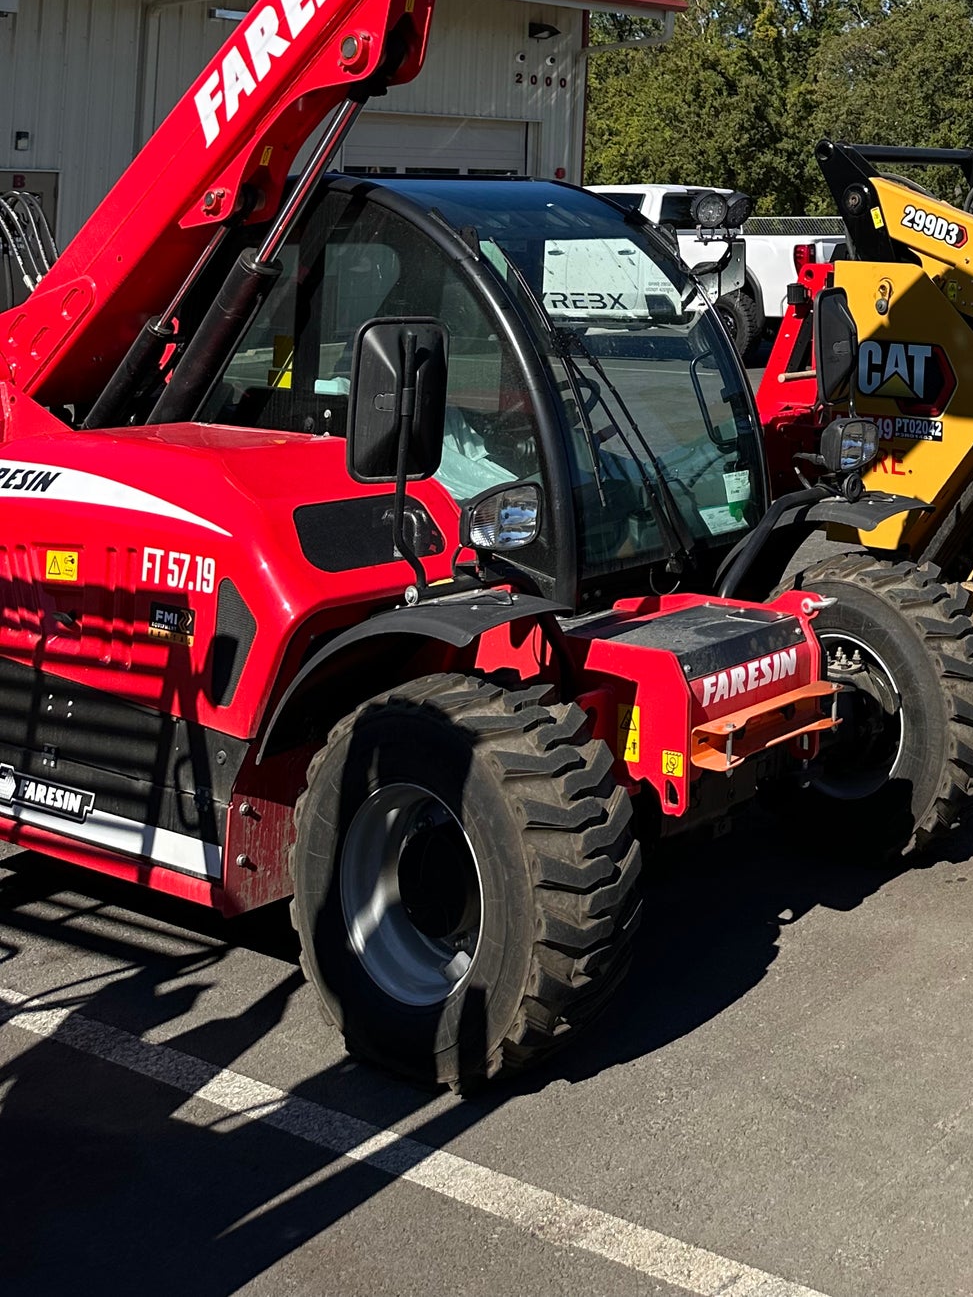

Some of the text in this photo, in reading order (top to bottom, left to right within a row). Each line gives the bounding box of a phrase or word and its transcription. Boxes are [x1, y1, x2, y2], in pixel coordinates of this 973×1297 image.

[901, 204, 960, 245] 299D3
[858, 340, 932, 399] CAT
[141, 546, 216, 594] FT 57.19
[155, 609, 178, 625] FMI
[701, 647, 797, 708] FARESIN
[18, 779, 83, 813] FARESIN
